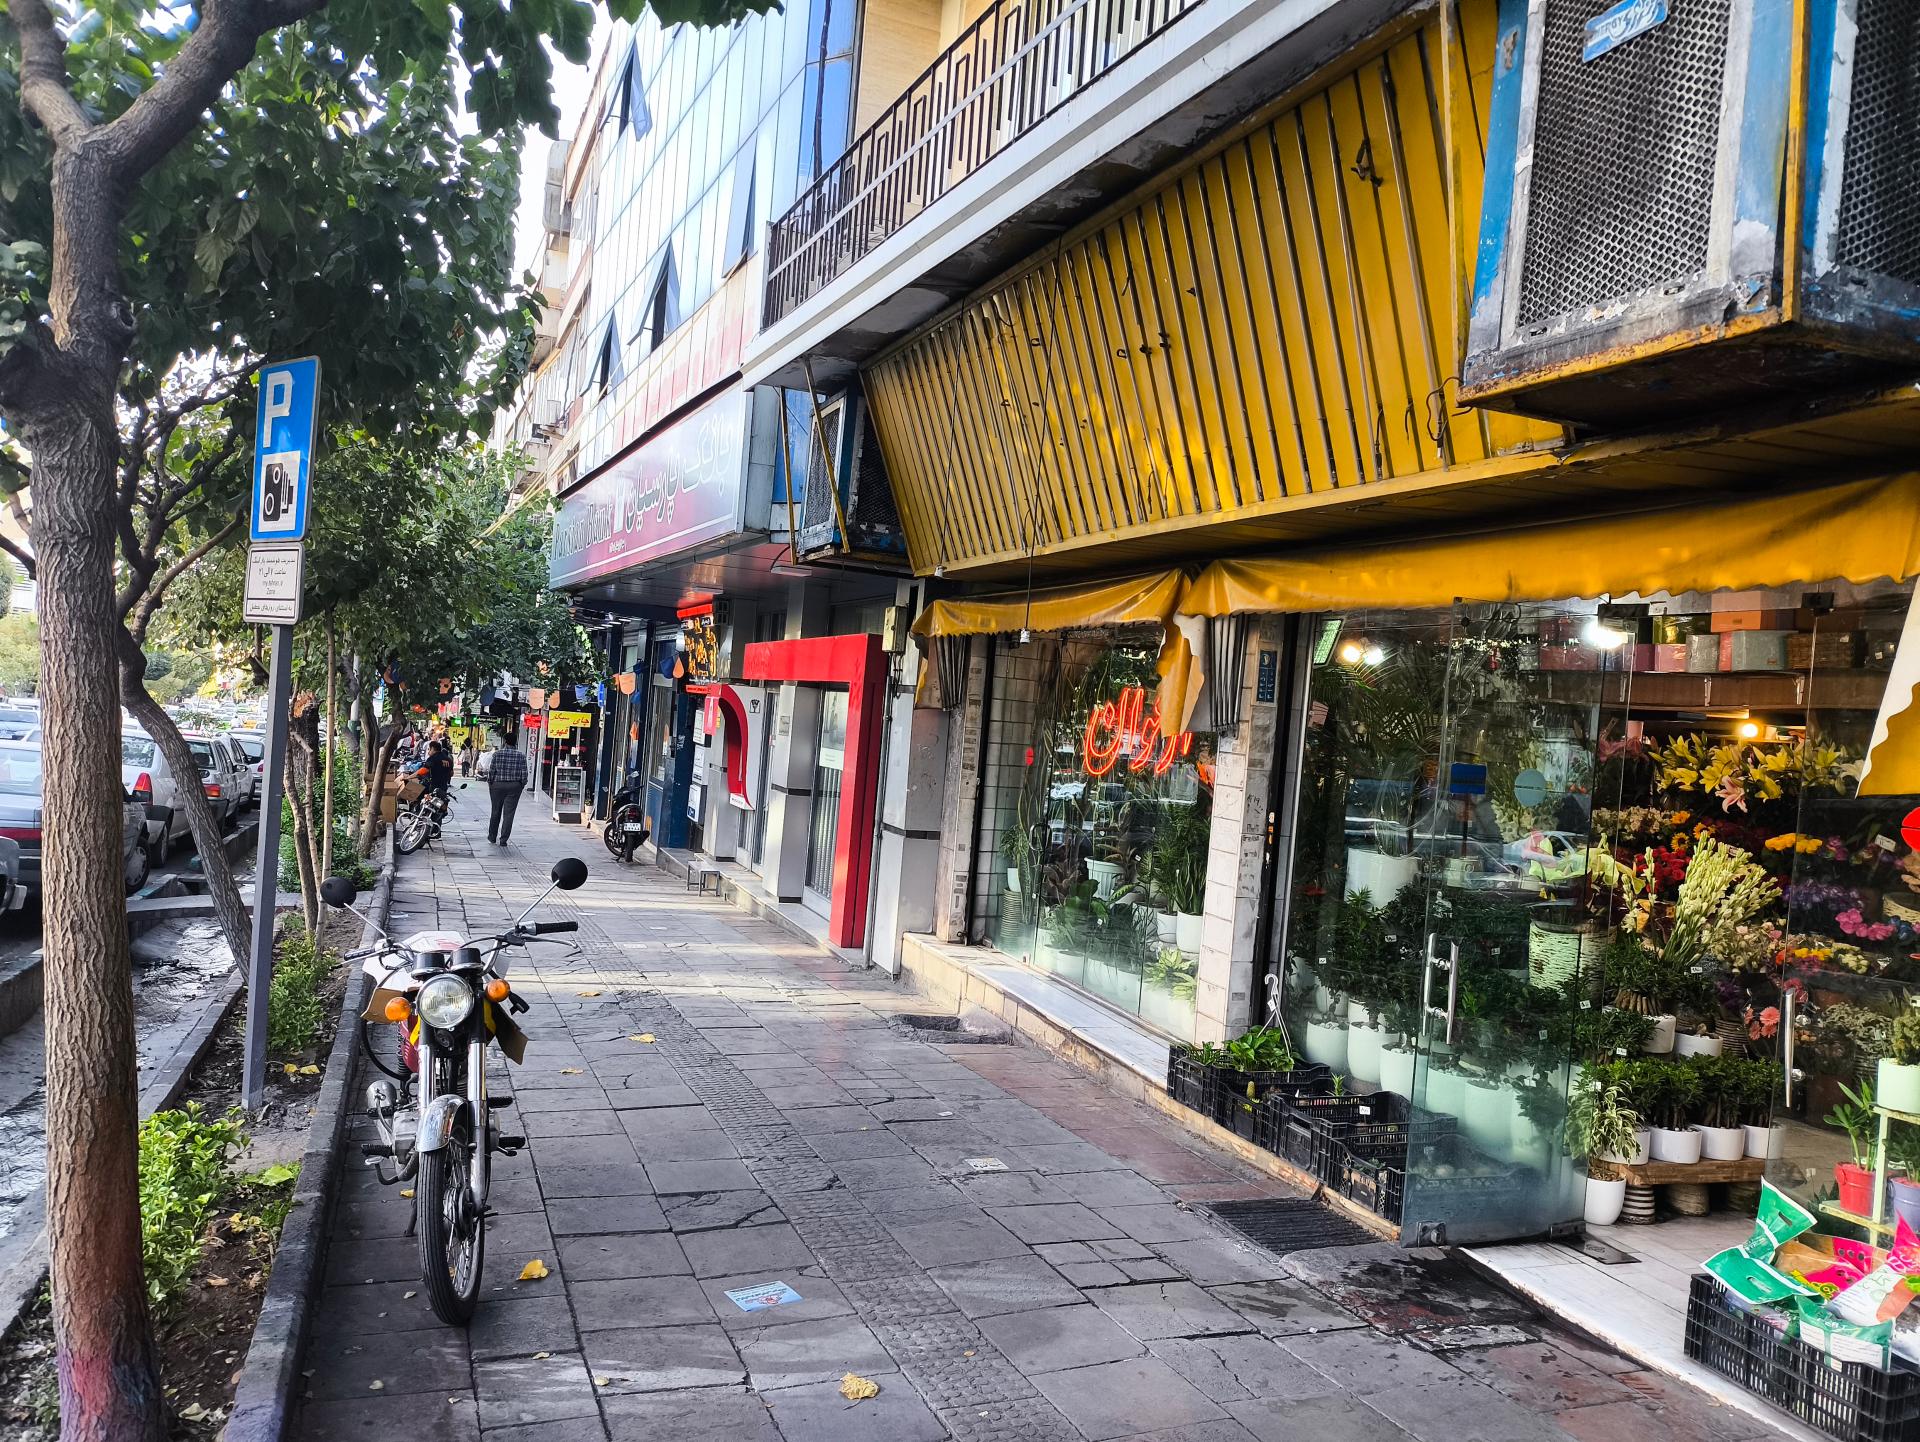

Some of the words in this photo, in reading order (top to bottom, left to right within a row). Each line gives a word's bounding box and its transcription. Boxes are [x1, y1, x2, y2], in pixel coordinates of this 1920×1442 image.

[263, 370, 293, 448] P
[625, 450, 680, 533] پارسیان
[680, 413, 733, 497] بانک
